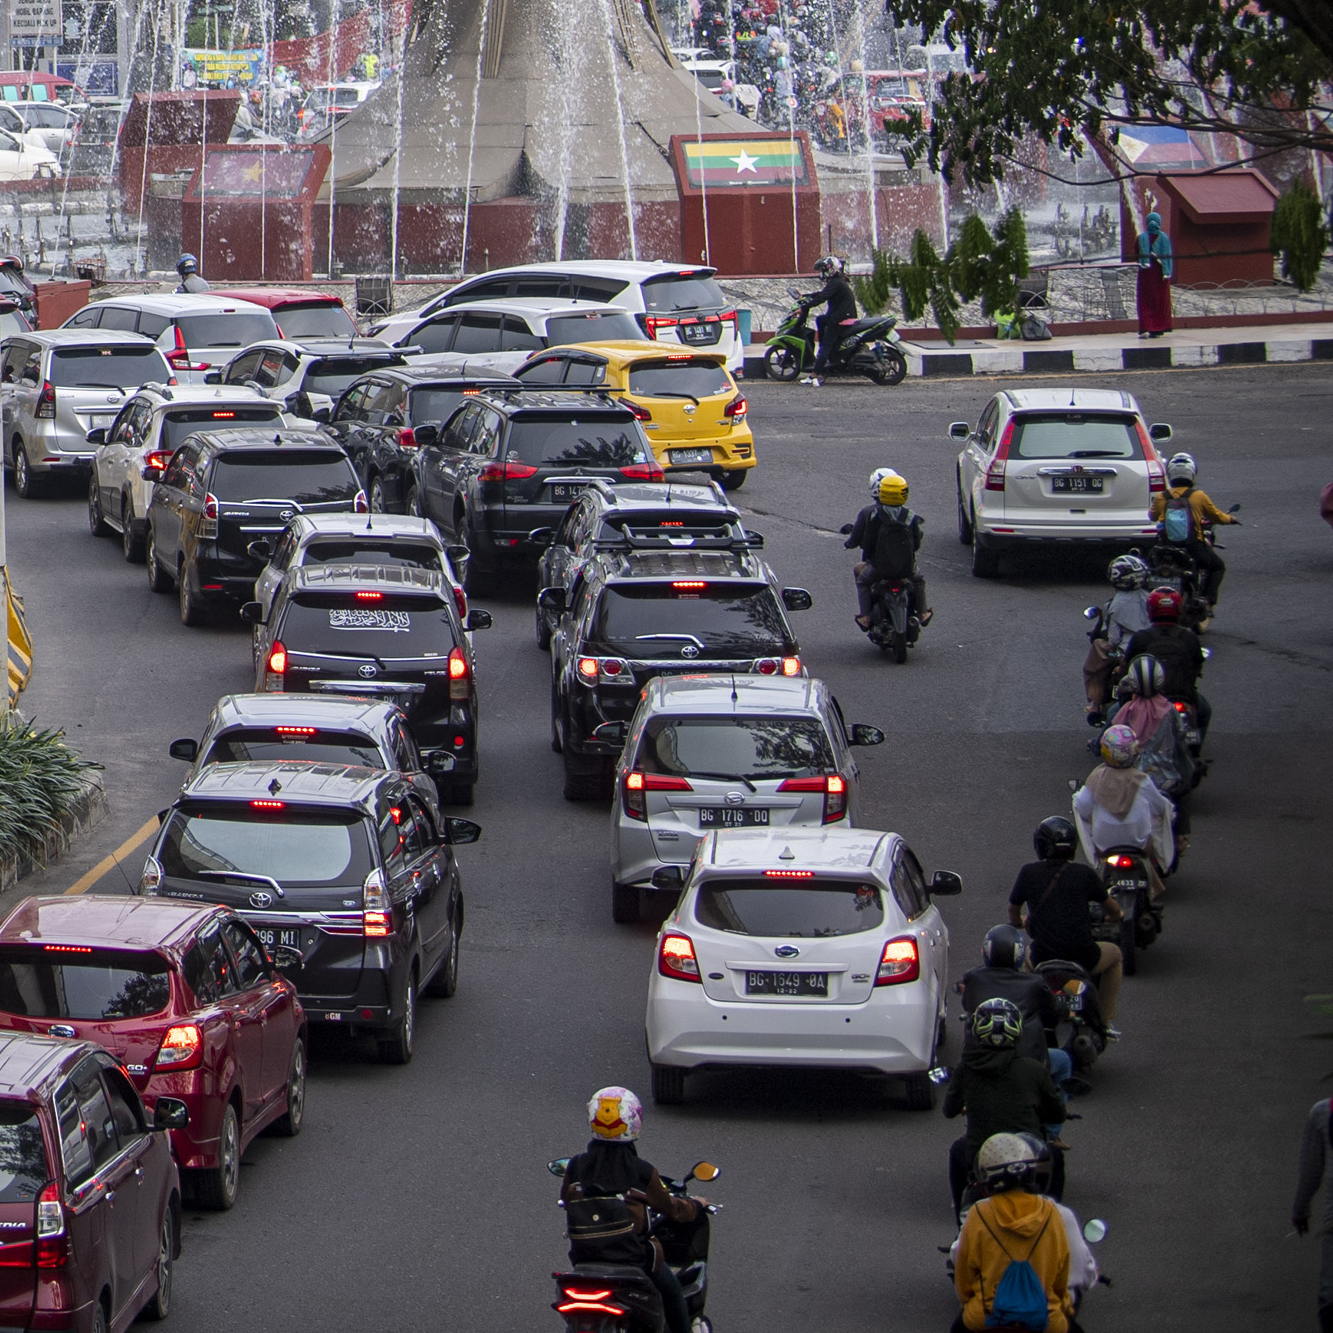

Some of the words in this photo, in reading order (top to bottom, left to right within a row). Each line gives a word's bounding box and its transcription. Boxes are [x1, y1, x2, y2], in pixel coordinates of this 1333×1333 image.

[1054, 478, 1065, 486] BG
[1069, 478, 1087, 486] 1151
[555, 486, 565, 495] BG
[701, 810, 713, 821] BG
[721, 810, 743, 821] 1716
[281, 930, 295, 944] MI
[749, 974, 764, 986] BG
[773, 973, 800, 986] 1649
